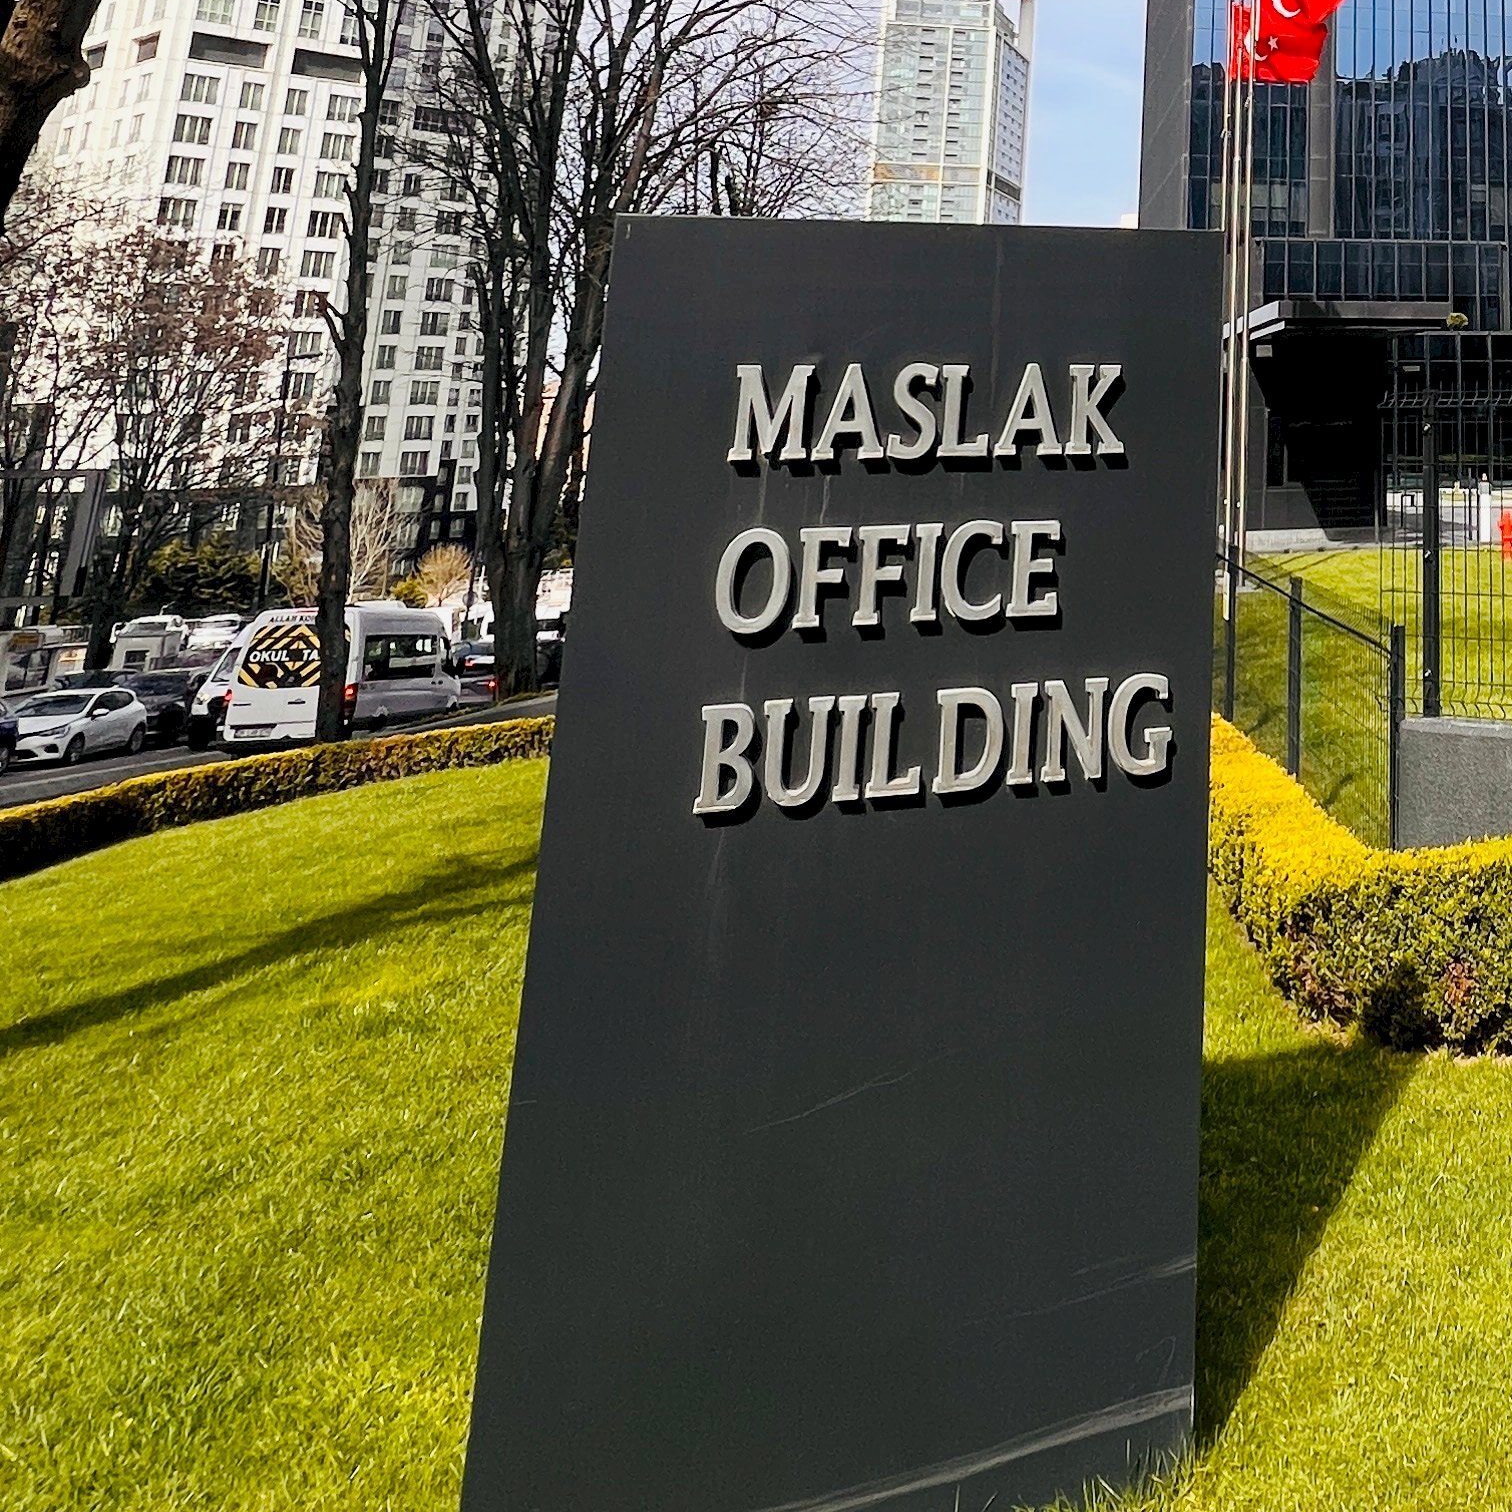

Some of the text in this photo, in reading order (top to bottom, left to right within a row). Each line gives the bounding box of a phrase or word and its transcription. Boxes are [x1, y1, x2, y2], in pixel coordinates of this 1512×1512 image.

[727, 362, 1124, 463] MASLAK
[715, 520, 1061, 635] OFFICE
[249, 650, 290, 663] OKUL
[692, 673, 1173, 815] BUILDING
